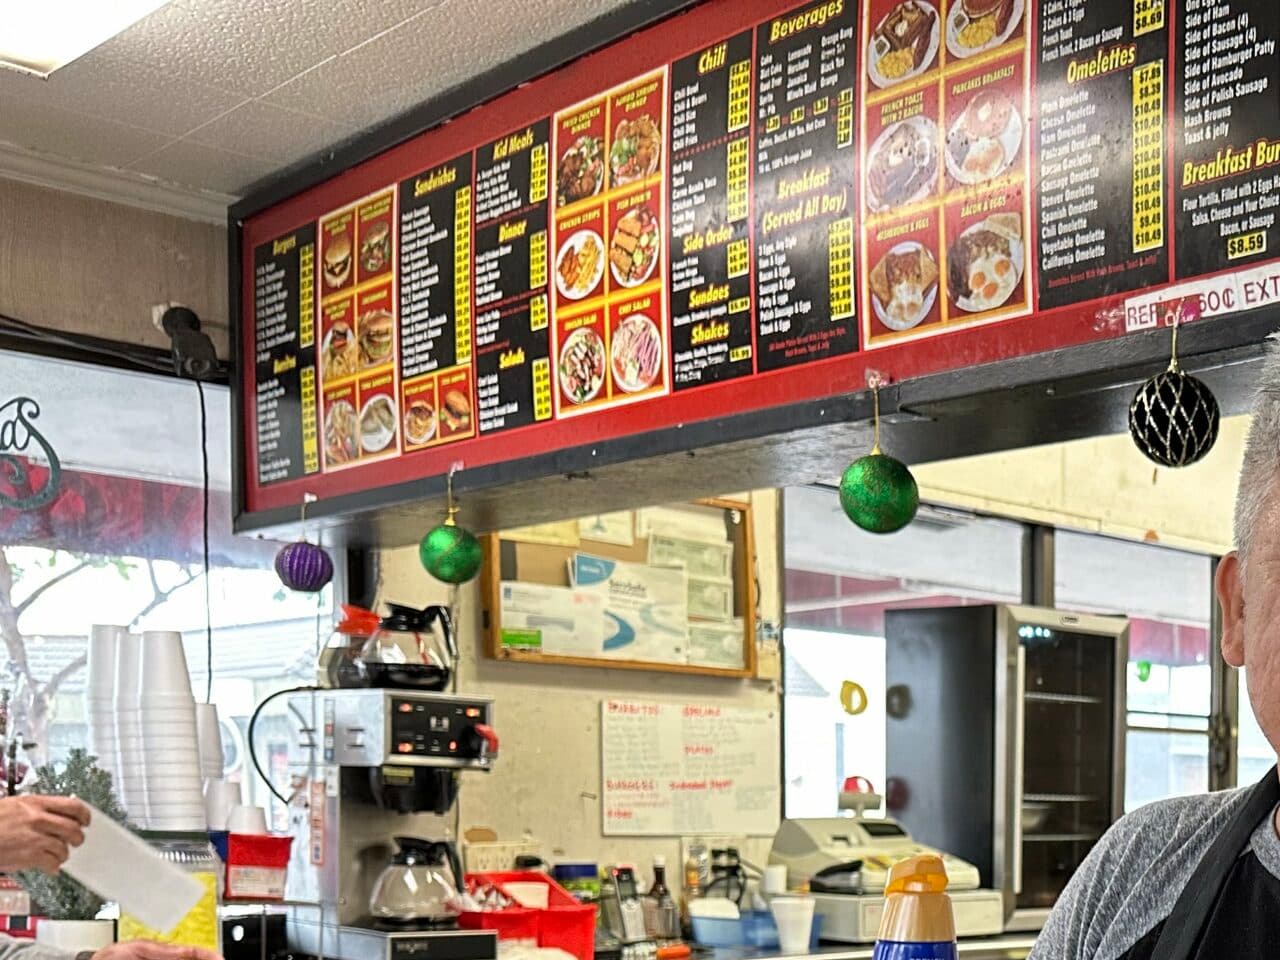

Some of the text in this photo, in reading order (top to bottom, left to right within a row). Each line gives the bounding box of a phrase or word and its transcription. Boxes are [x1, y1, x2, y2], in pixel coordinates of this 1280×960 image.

[770, 0, 843, 42] Beverages
[1185, 5, 1230, 29] Side of Ham
[1185, 29, 1201, 45] Side
[1203, 25, 1211, 38] of
[1212, 19, 1236, 34] Bacon
[698, 43, 728, 73] Chili
[1184, 40, 1275, 79] Side of Hamburger Patty
[1185, 46, 1201, 62] Side
[1203, 42, 1211, 56] of
[1212, 33, 1244, 53] Sausage
[1067, 46, 1135, 84] Omelettes
[1184, 67, 1243, 95] Side of Avocado
[1184, 77, 1268, 112] Side of Polish Sausage
[1184, 106, 1231, 129] Hash Browns
[1184, 129, 1204, 145] Toast
[1182, 147, 1252, 186] Breakfast
[777, 167, 831, 200] Breakfast
[1249, 213, 1274, 228] Sausage
[1229, 234, 1263, 255] $8.59
